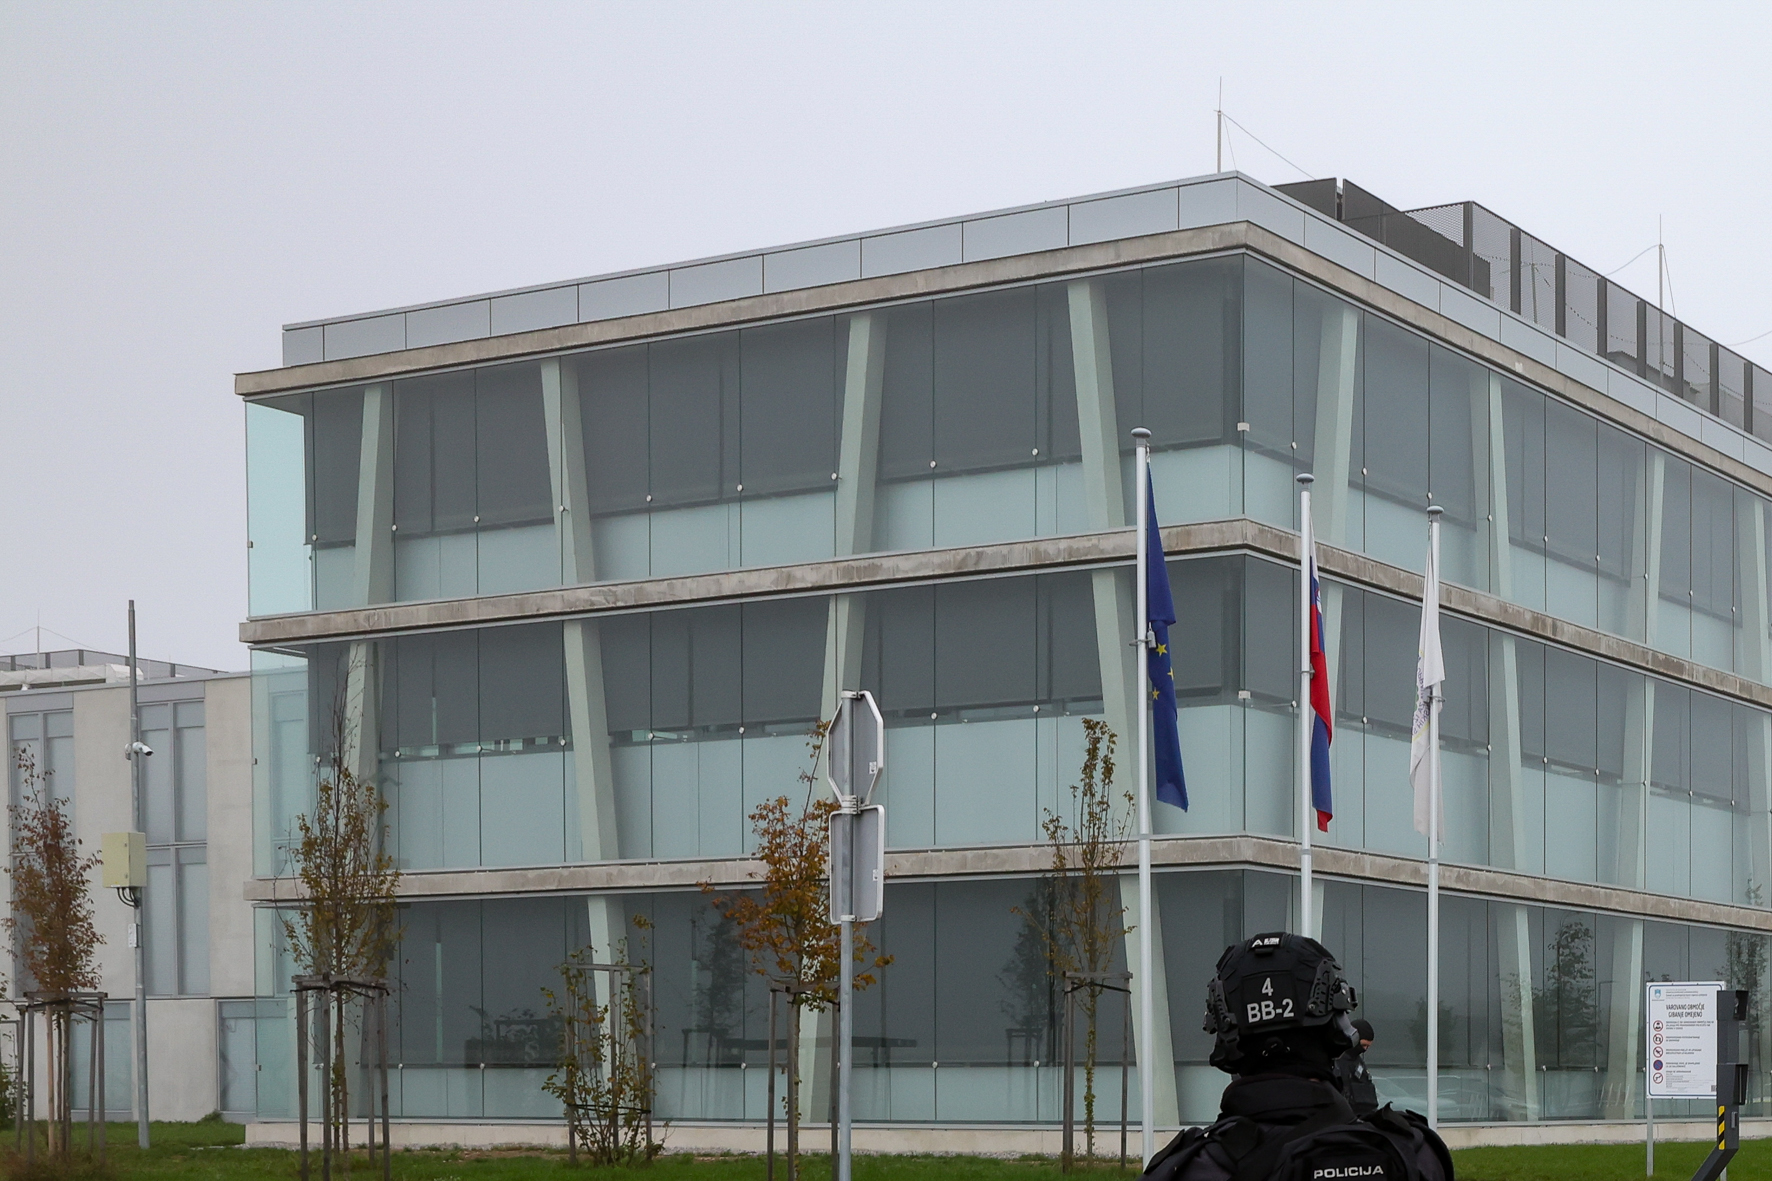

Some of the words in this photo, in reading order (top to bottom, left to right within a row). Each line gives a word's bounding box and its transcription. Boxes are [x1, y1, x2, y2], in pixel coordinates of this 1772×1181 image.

[1261, 977, 1274, 997] 4
[1246, 998, 1295, 1024] BB-2
[1313, 1165, 1384, 1180] POLICIJA
